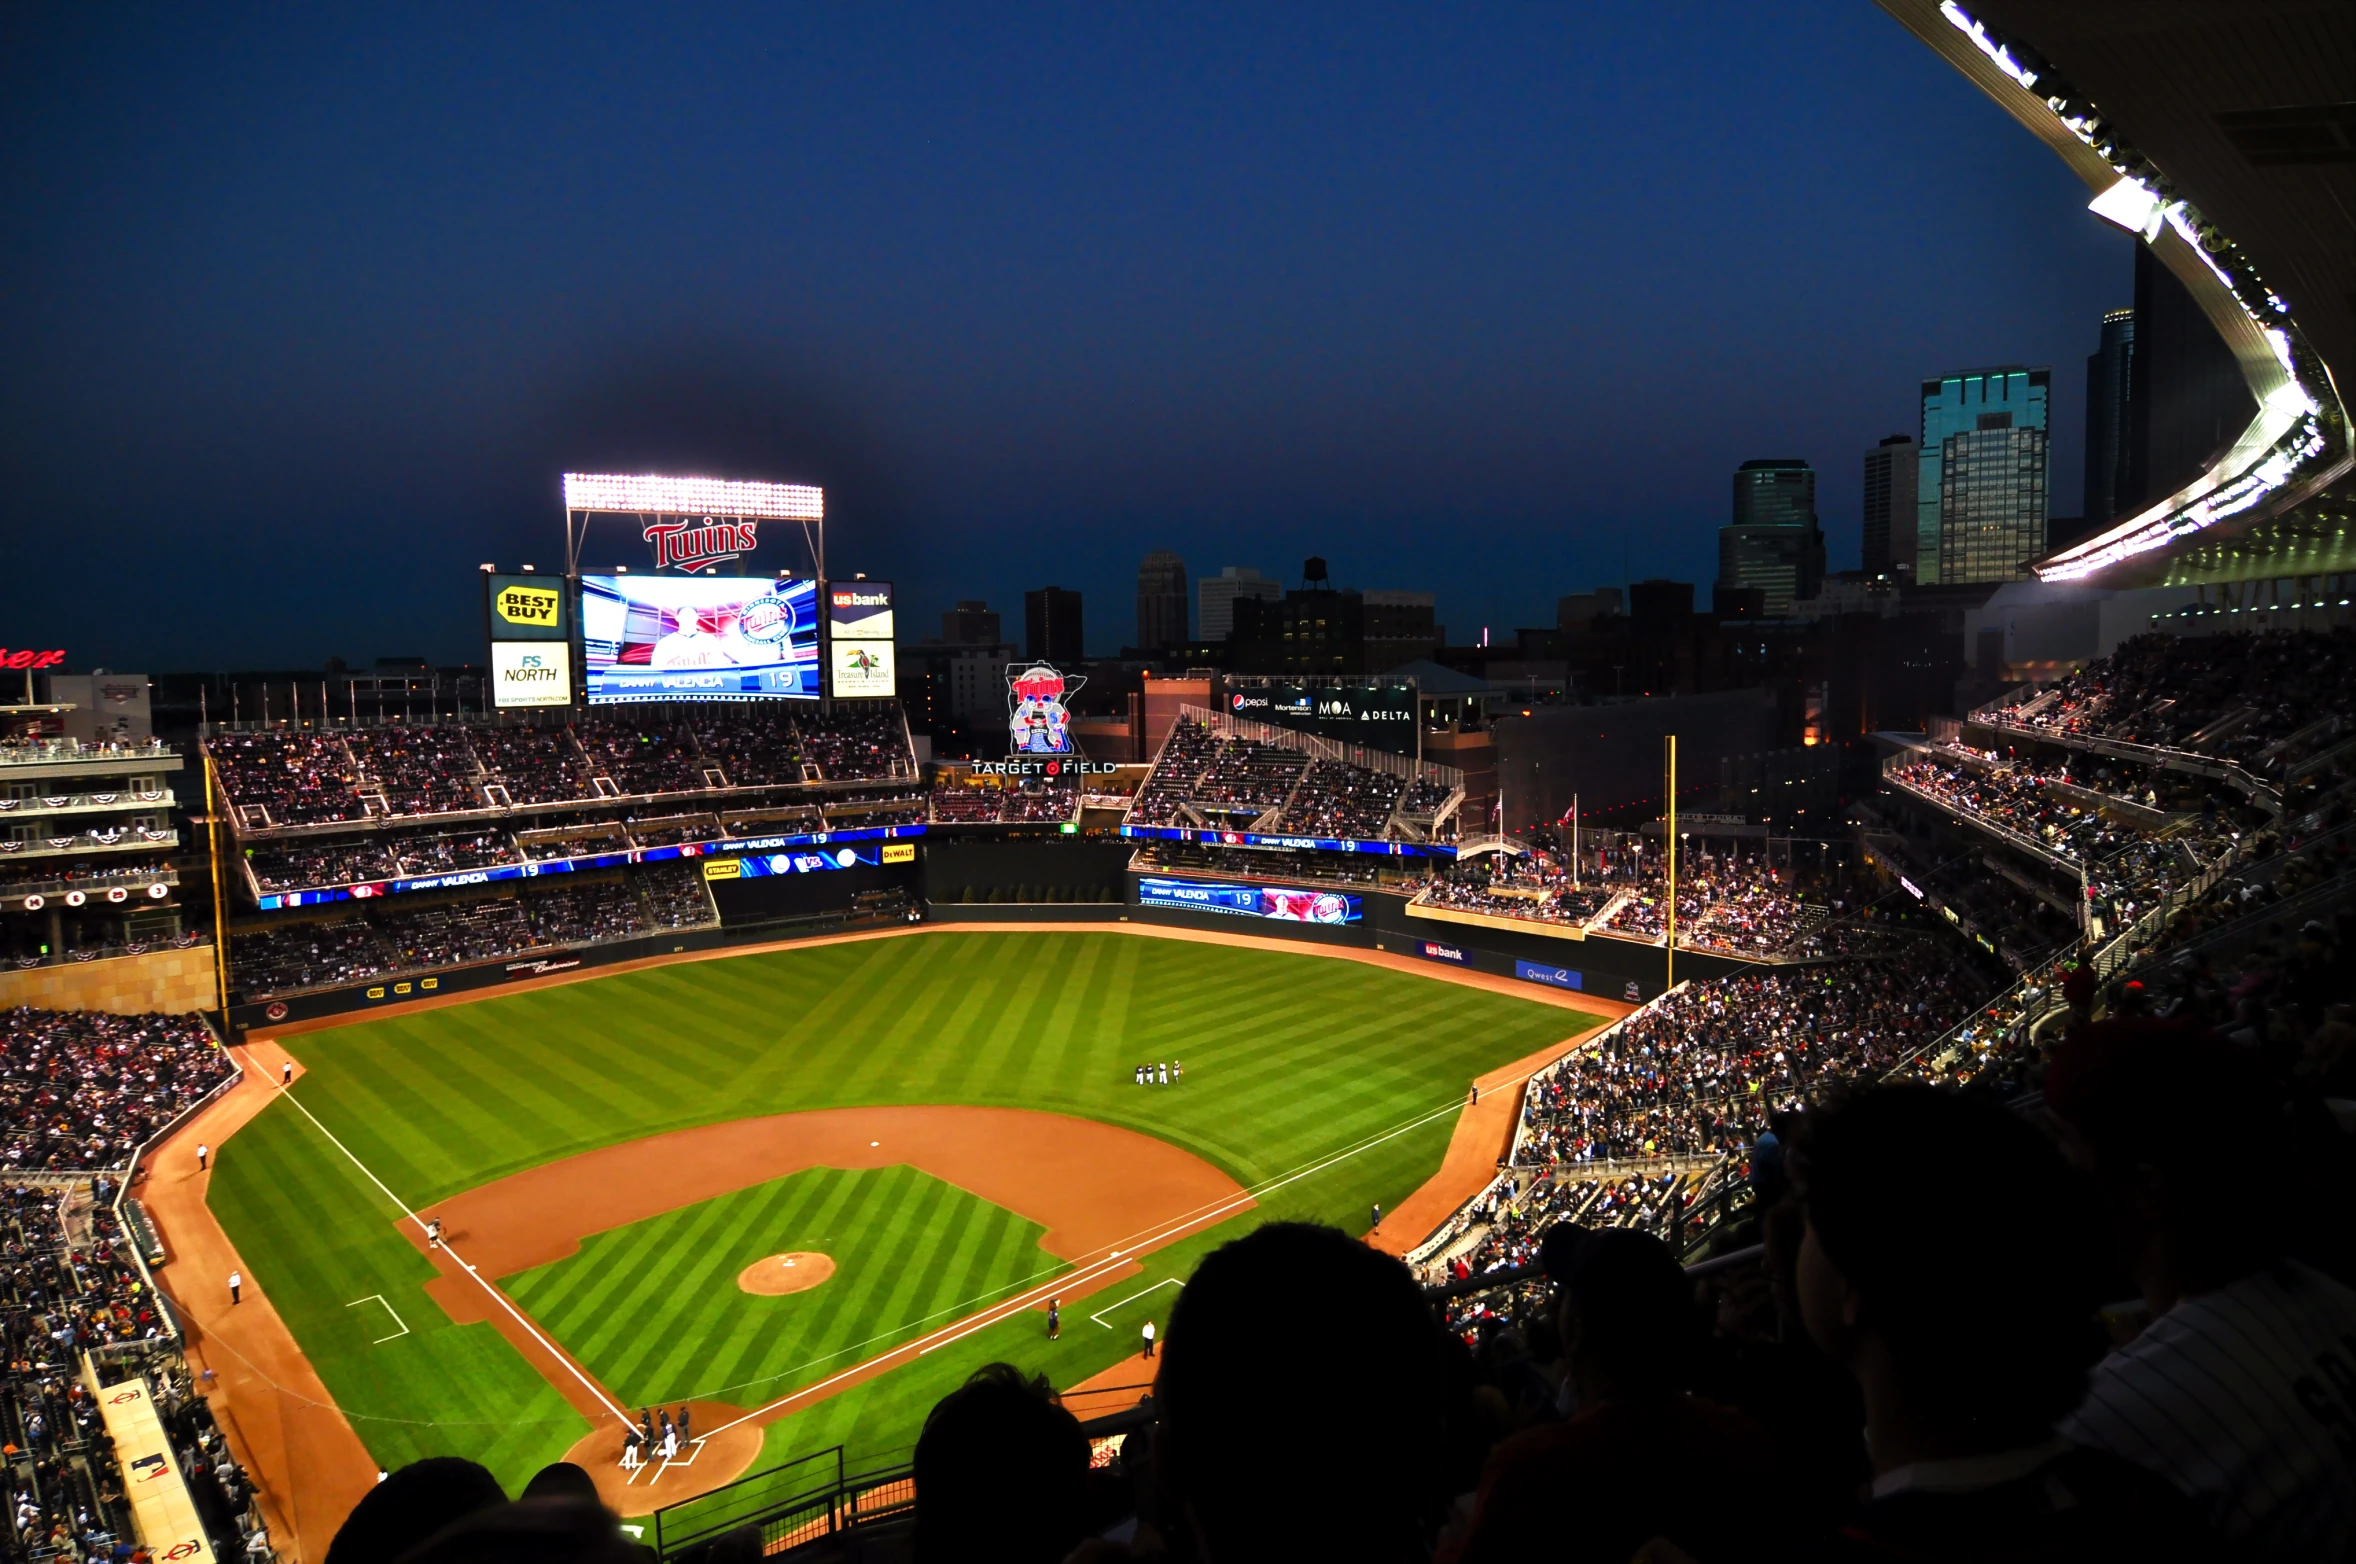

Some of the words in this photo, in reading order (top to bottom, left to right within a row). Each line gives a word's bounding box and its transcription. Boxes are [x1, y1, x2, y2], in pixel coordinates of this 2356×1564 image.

[643, 517, 757, 570] Twins
[505, 593, 556, 608] BEST
[507, 606, 551, 619] BUY
[740, 606, 788, 633] Twins
[522, 655, 542, 668] FS
[504, 668, 557, 682] NORTH
[619, 678, 656, 688] DANNY
[661, 675, 724, 688] VALENCIA
[768, 671, 793, 688] 19
[837, 669, 864, 679] Treasure
[870, 668, 889, 678] Island
[1012, 676, 1065, 703] Twins
[1245, 697, 1268, 708] pepsi
[1372, 710, 1410, 721] DELTA
[972, 763, 1044, 774] TARGET
[1063, 762, 1116, 774] FIELD
[722, 842, 746, 851] DANNY
[746, 838, 786, 849] VALENCIA
[811, 833, 828, 844] 19
[1261, 837, 1280, 846] DANNY
[1281, 838, 1316, 849] VALENCIA
[1340, 840, 1355, 851] 19
[411, 879, 440, 890] DANNY
[441, 872, 489, 887] VALENCIA
[520, 864, 539, 877] 19
[708, 865, 737, 875] STANLEY
[1151, 887, 1172, 896] DANNY
[1173, 888, 1210, 901] VALENCIA
[1235, 893, 1251, 906] 19
[1527, 968, 1553, 981] Qwest
